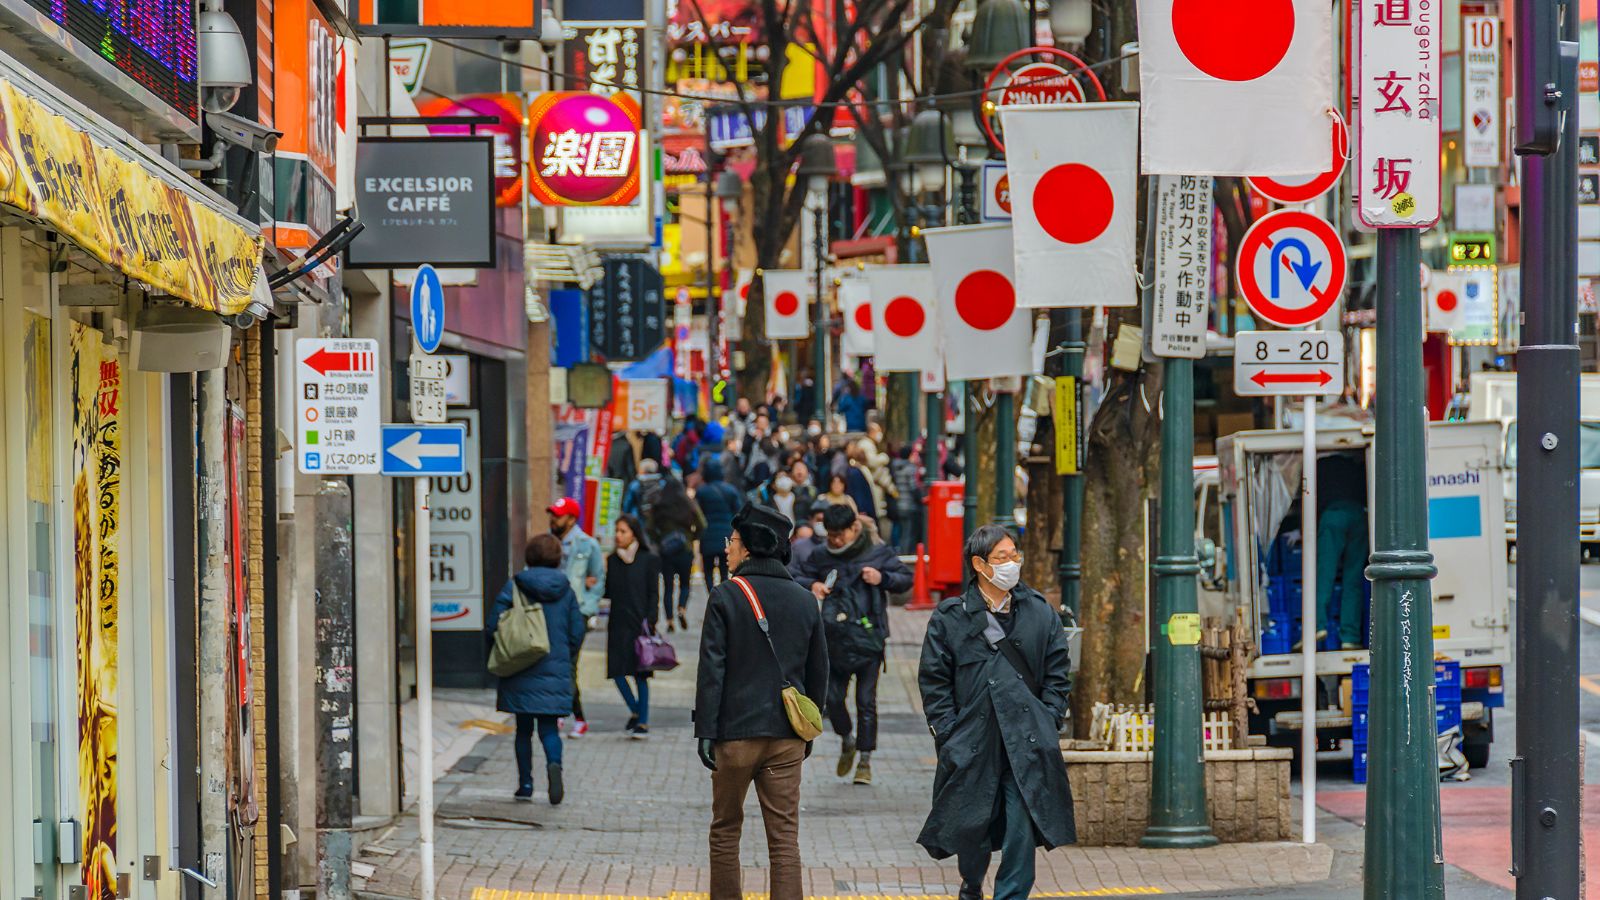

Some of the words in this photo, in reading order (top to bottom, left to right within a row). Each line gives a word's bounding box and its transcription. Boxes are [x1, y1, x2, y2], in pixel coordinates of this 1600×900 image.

[1471, 21, 1493, 48] 10
[1373, 0, 1412, 200] 道玄坂
[541, 128, 636, 177] 楽園
[365, 177, 473, 193] EXCELSIOR
[387, 193, 450, 212] CAFFÉ
[1176, 175, 1197, 328] 防犯カメラ作動中
[1195, 175, 1209, 314] なさまの安全を守ります
[1167, 344, 1191, 352] Police
[1256, 341, 1268, 360] 8
[1300, 341, 1328, 360] 20
[324, 382, 369, 395] 井の頭線
[325, 406, 358, 418] 銀座線
[325, 453, 376, 465] バスのりば
